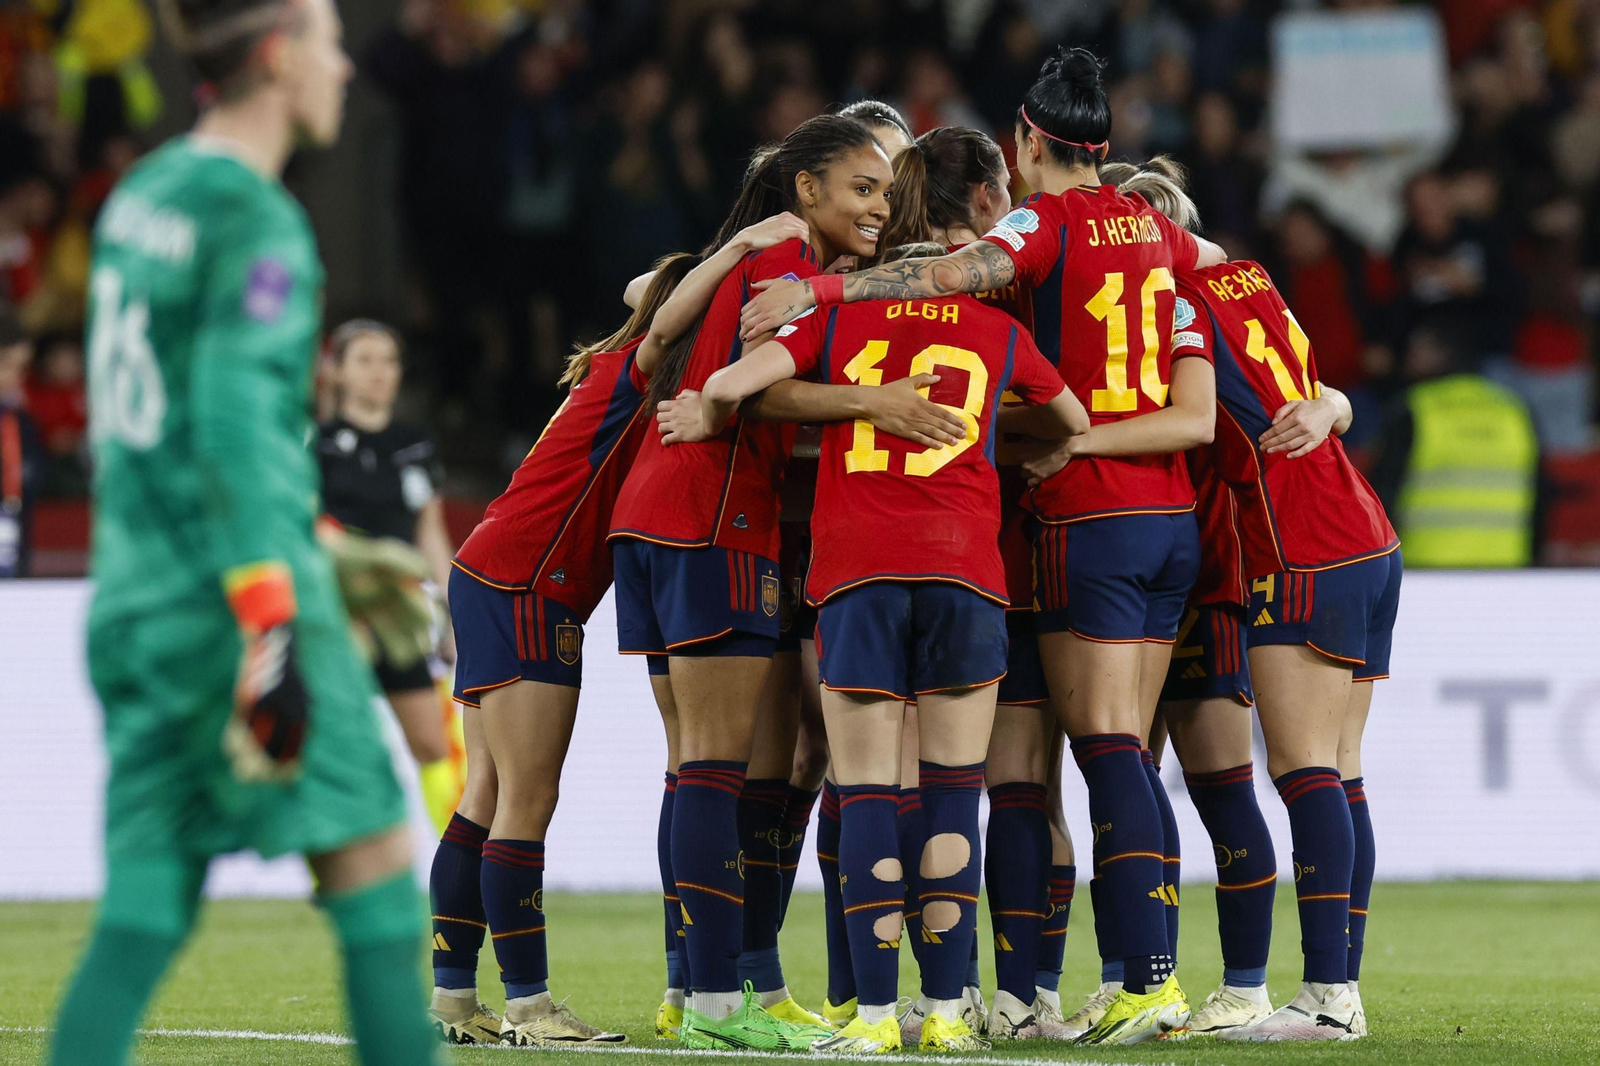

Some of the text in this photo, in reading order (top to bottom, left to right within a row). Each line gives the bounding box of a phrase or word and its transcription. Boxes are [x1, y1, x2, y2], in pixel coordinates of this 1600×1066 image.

[886, 300, 959, 324] OLGA
[1084, 267, 1176, 412] 10
[843, 340, 988, 477] 19
[1234, 848, 1248, 858] 09
[724, 860, 736, 869] 19
[519, 898, 531, 907] 19
